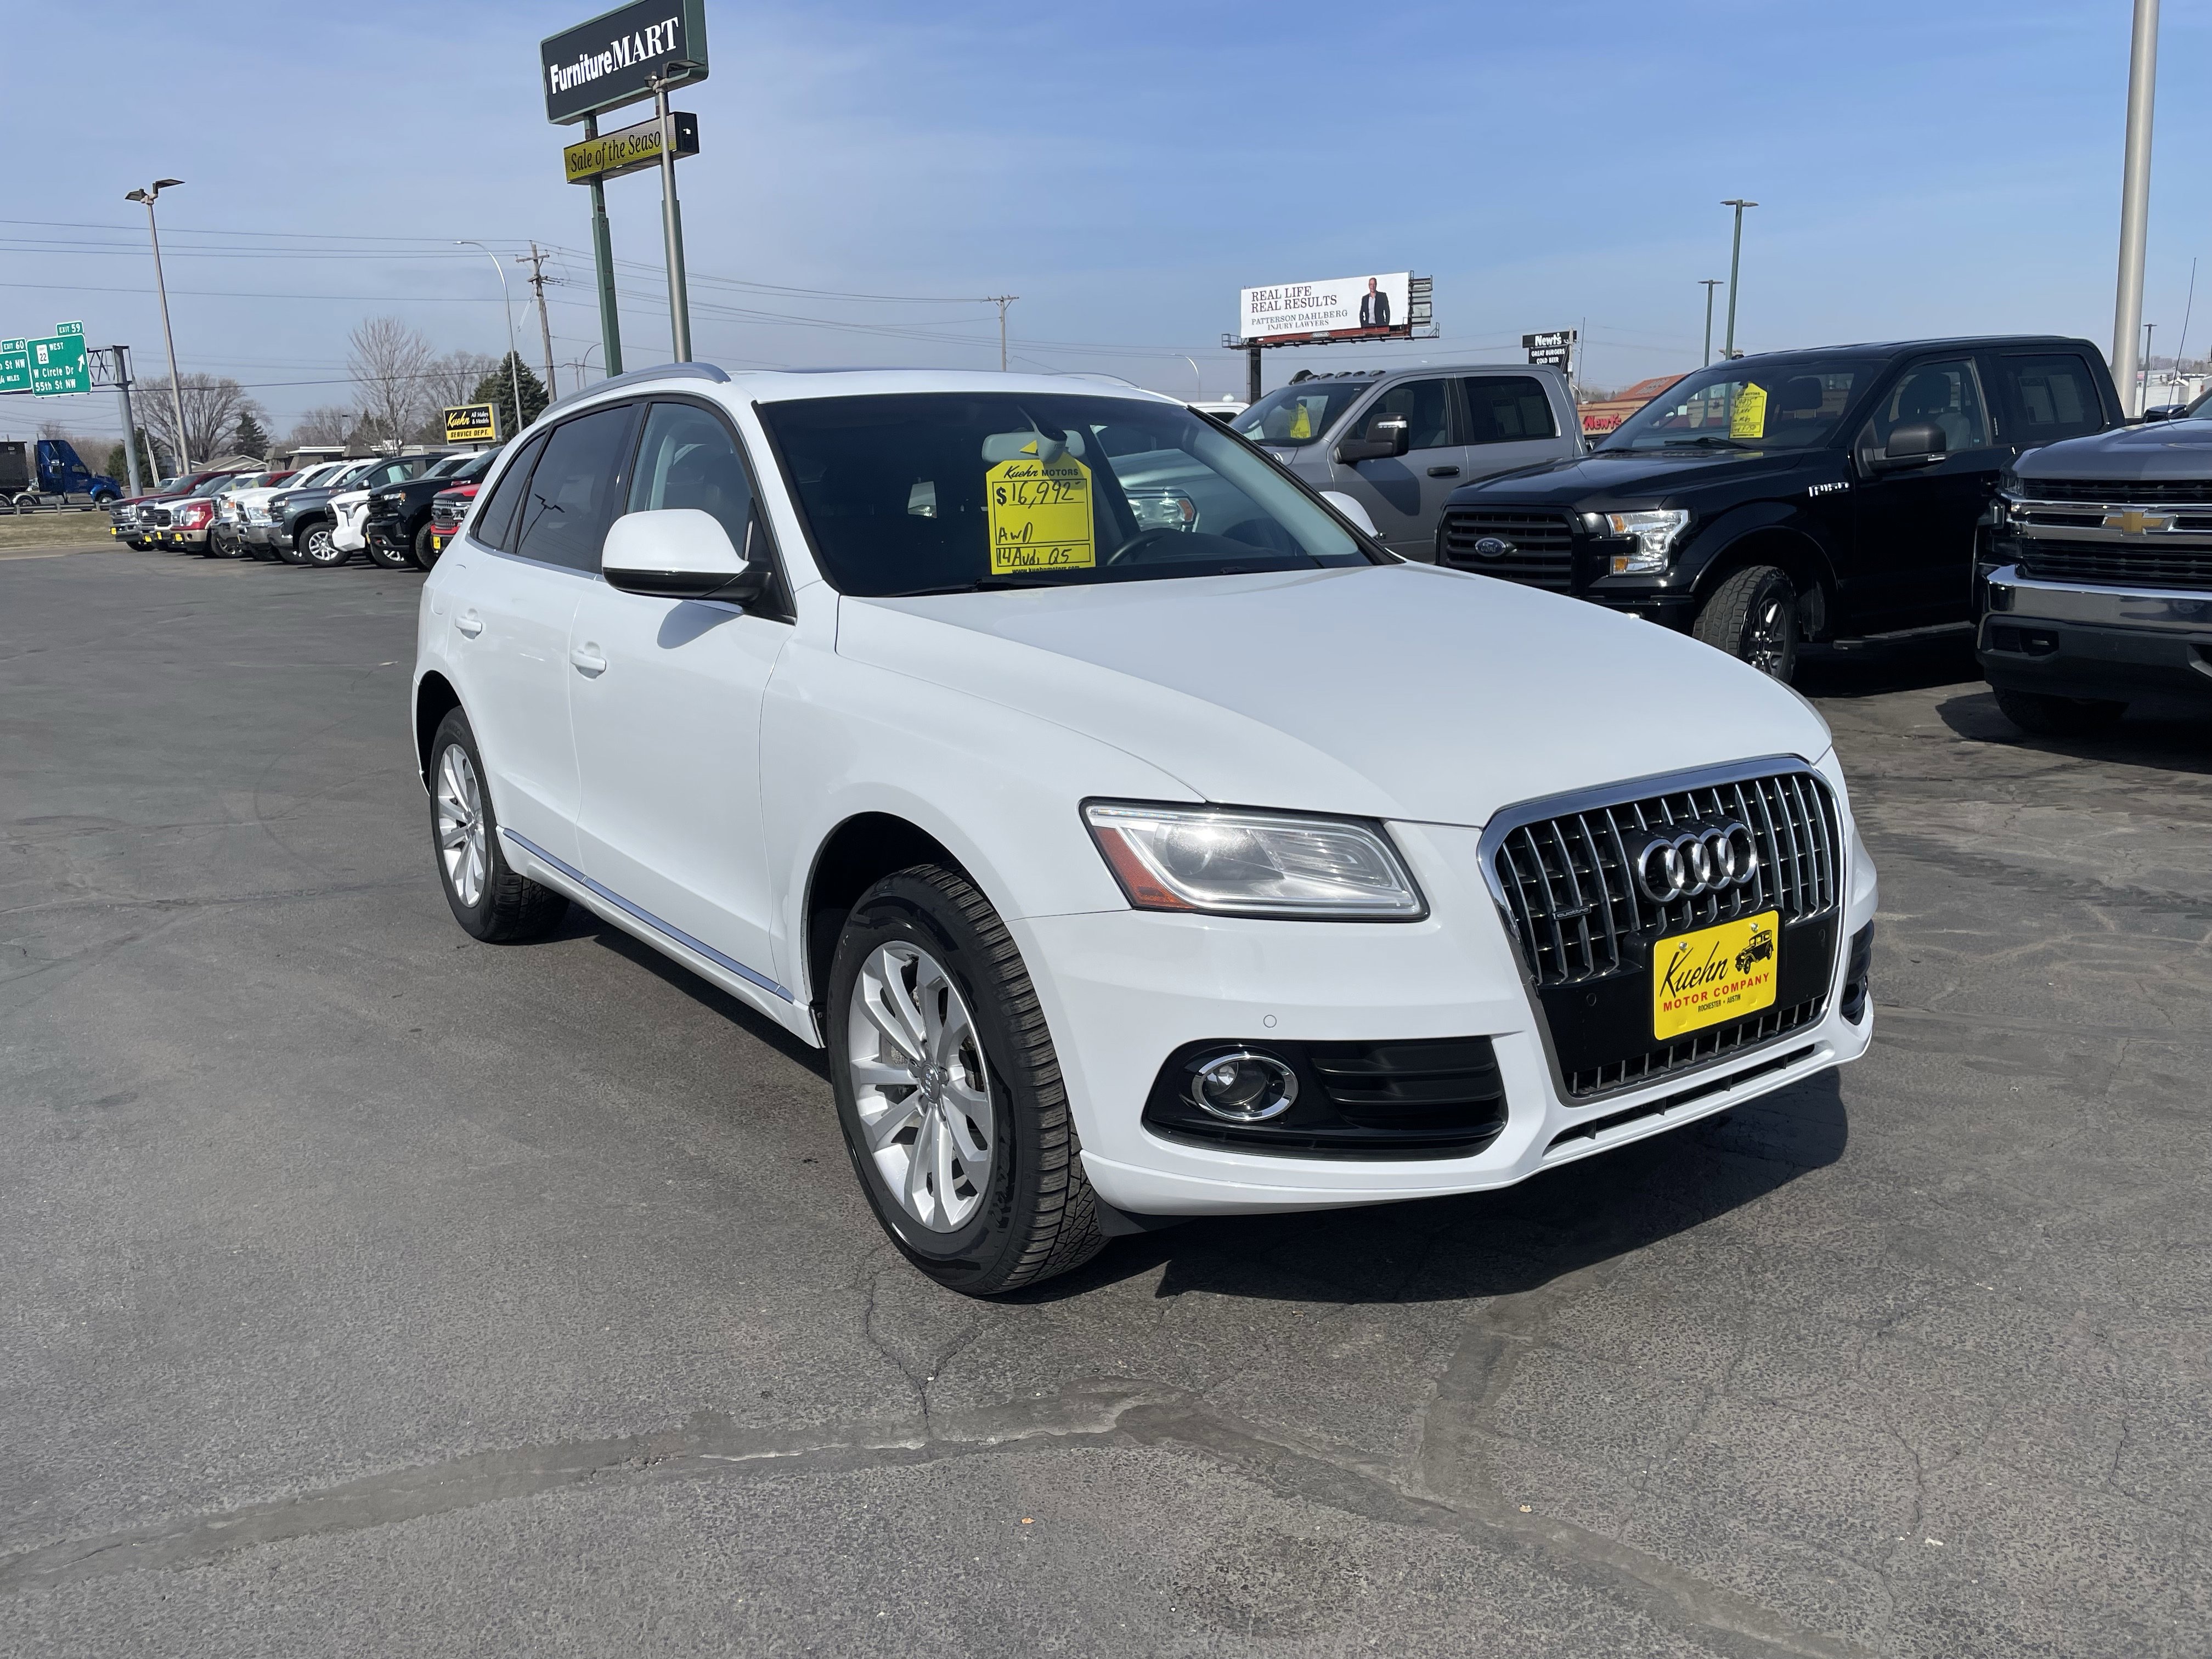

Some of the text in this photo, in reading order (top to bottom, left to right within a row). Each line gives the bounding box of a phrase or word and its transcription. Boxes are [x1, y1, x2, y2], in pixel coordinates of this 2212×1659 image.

[550, 16, 679, 94] FurnitureMART
[571, 131, 662, 172] Sale of the Seaso
[1251, 286, 1312, 302] REAL LIFE
[1251, 295, 1338, 313] REAL RESULTS
[1251, 309, 1348, 325] PATTERSON DAHLBERG
[71, 323, 81, 333] 59
[1267, 319, 1329, 330] INJURY LAWYERS
[15, 341, 24, 349] 60
[1535, 332, 1562, 346] Newt's
[49, 342, 64, 351] WEST
[1545, 348, 1565, 356] BURGERS
[5, 360, 13, 370] St
[15, 359, 25, 369] NW
[40, 353, 47, 362] 22
[7, 374, 20, 382] MILES
[33, 365, 74, 379] W Circle Dr
[35, 379, 76, 392] 55th St NW
[447, 410, 470, 428] Kuehn
[1583, 413, 1622, 431] Newt's
[1003, 465, 1038, 479] Kuehn
[997, 547, 1073, 566] 14 Audi Q5
[1660, 940, 1729, 998] Kuehn
[1663, 972, 1770, 1013] MOTOR COMPANY
[1698, 994, 1741, 1013] ROCHESTER AUSTIN
